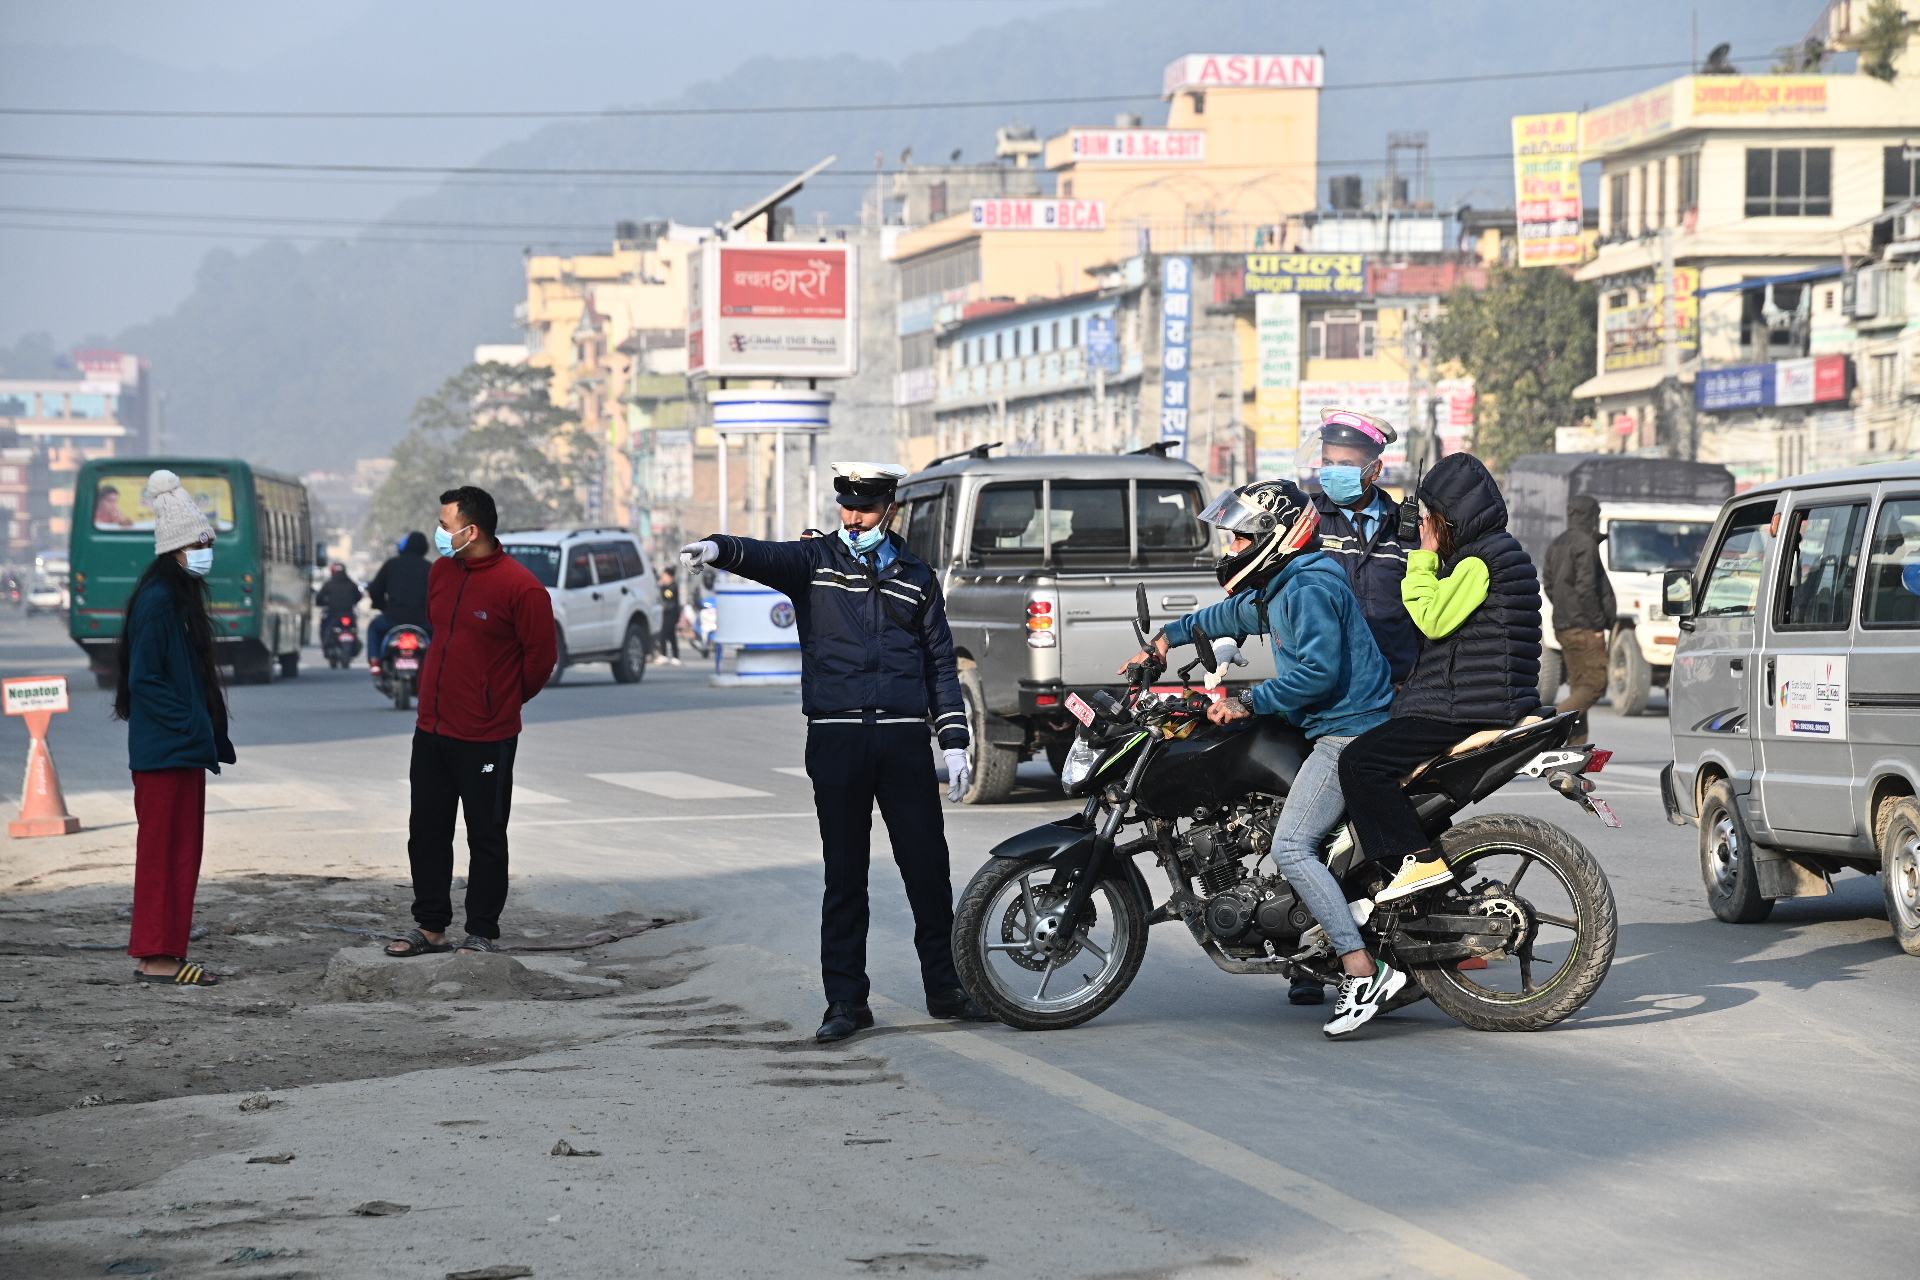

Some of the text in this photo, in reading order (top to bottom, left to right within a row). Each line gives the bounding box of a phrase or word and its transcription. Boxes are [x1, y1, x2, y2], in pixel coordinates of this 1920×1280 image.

[1199, 57, 1315, 83] ASIAN
[1080, 134, 1109, 156] BIM
[986, 203, 1100, 227] BBM BCA
[1246, 254, 1363, 275] पायल्स
[749, 333, 782, 345] Global
[812, 334, 837, 346] Bank
[8, 685, 60, 699] Nepatop
